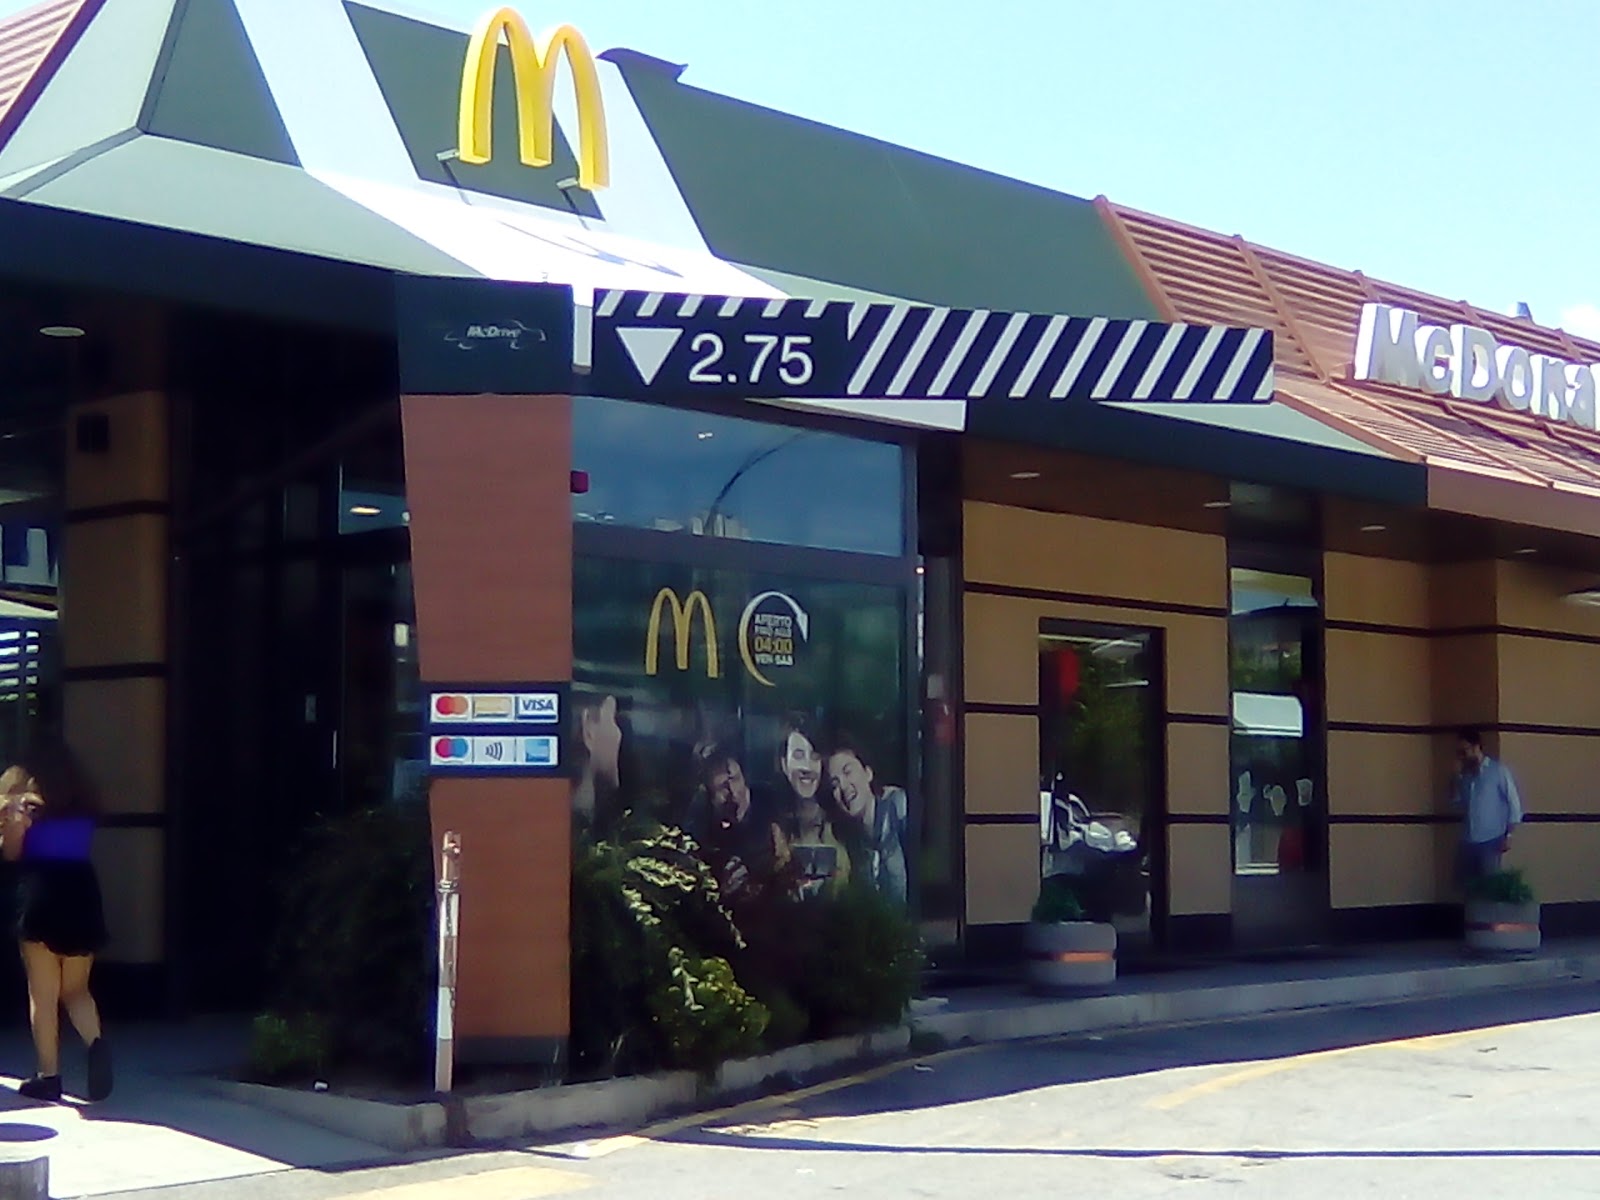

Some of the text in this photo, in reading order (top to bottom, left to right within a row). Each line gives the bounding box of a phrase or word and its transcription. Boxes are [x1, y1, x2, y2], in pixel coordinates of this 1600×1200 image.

[467, 325, 522, 338] McDrive
[689, 333, 813, 385] 2.75
[755, 637, 792, 654] 04:00
[522, 699, 554, 710] VISA
